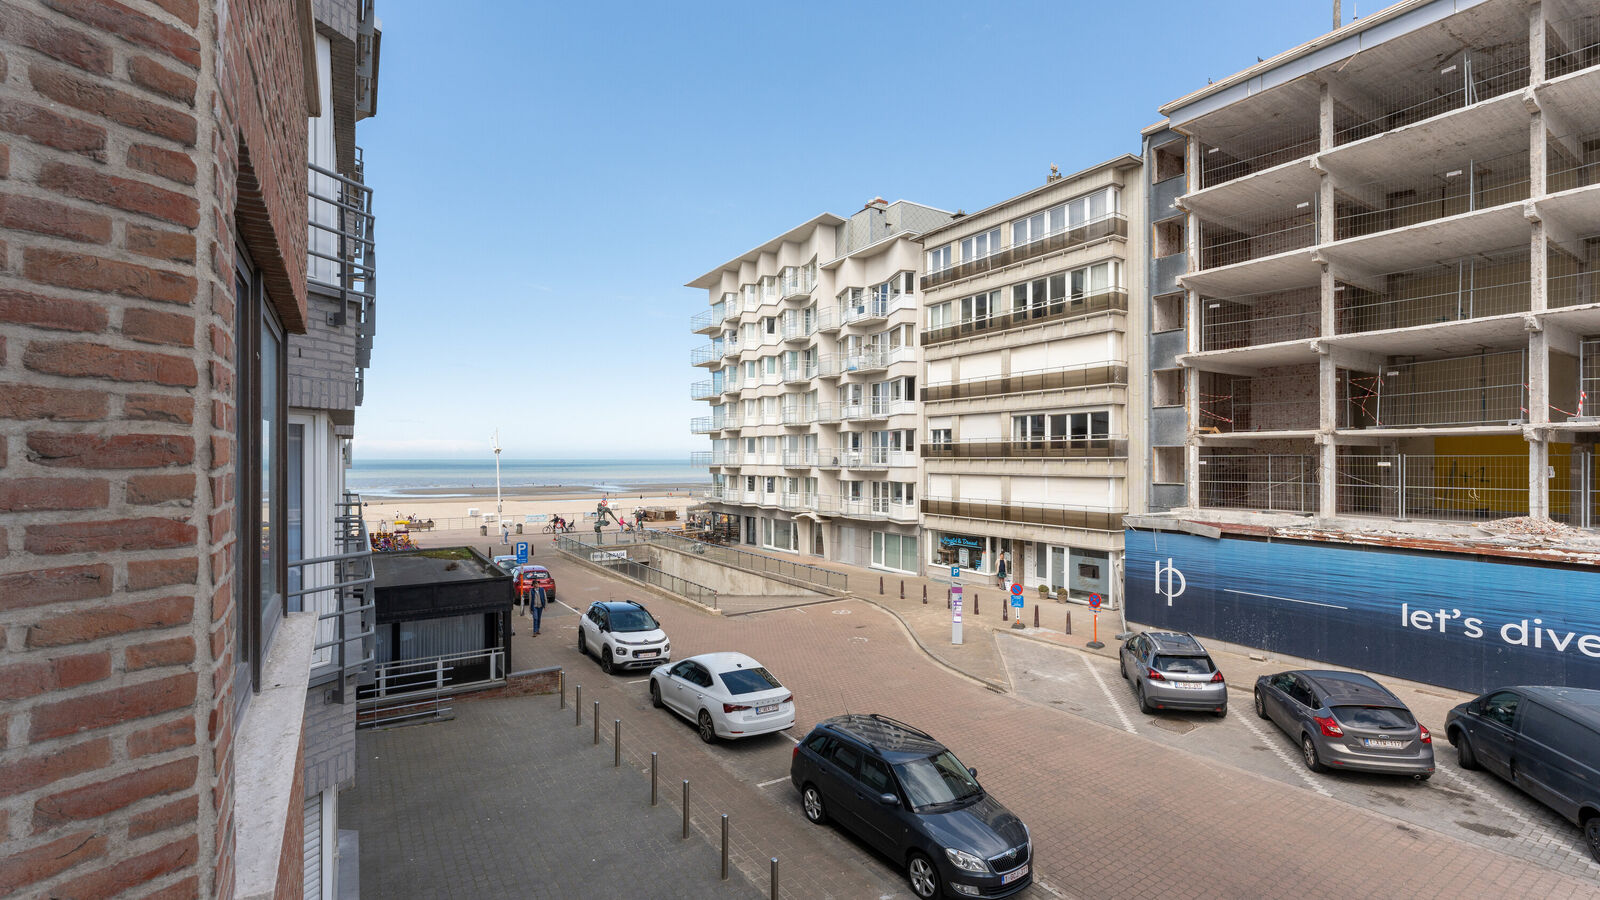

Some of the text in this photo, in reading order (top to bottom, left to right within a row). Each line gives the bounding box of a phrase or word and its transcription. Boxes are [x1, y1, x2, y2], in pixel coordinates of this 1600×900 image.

[518, 543, 526, 555] P
[953, 568, 959, 576] P
[1402, 602, 1600, 658] let's dive
